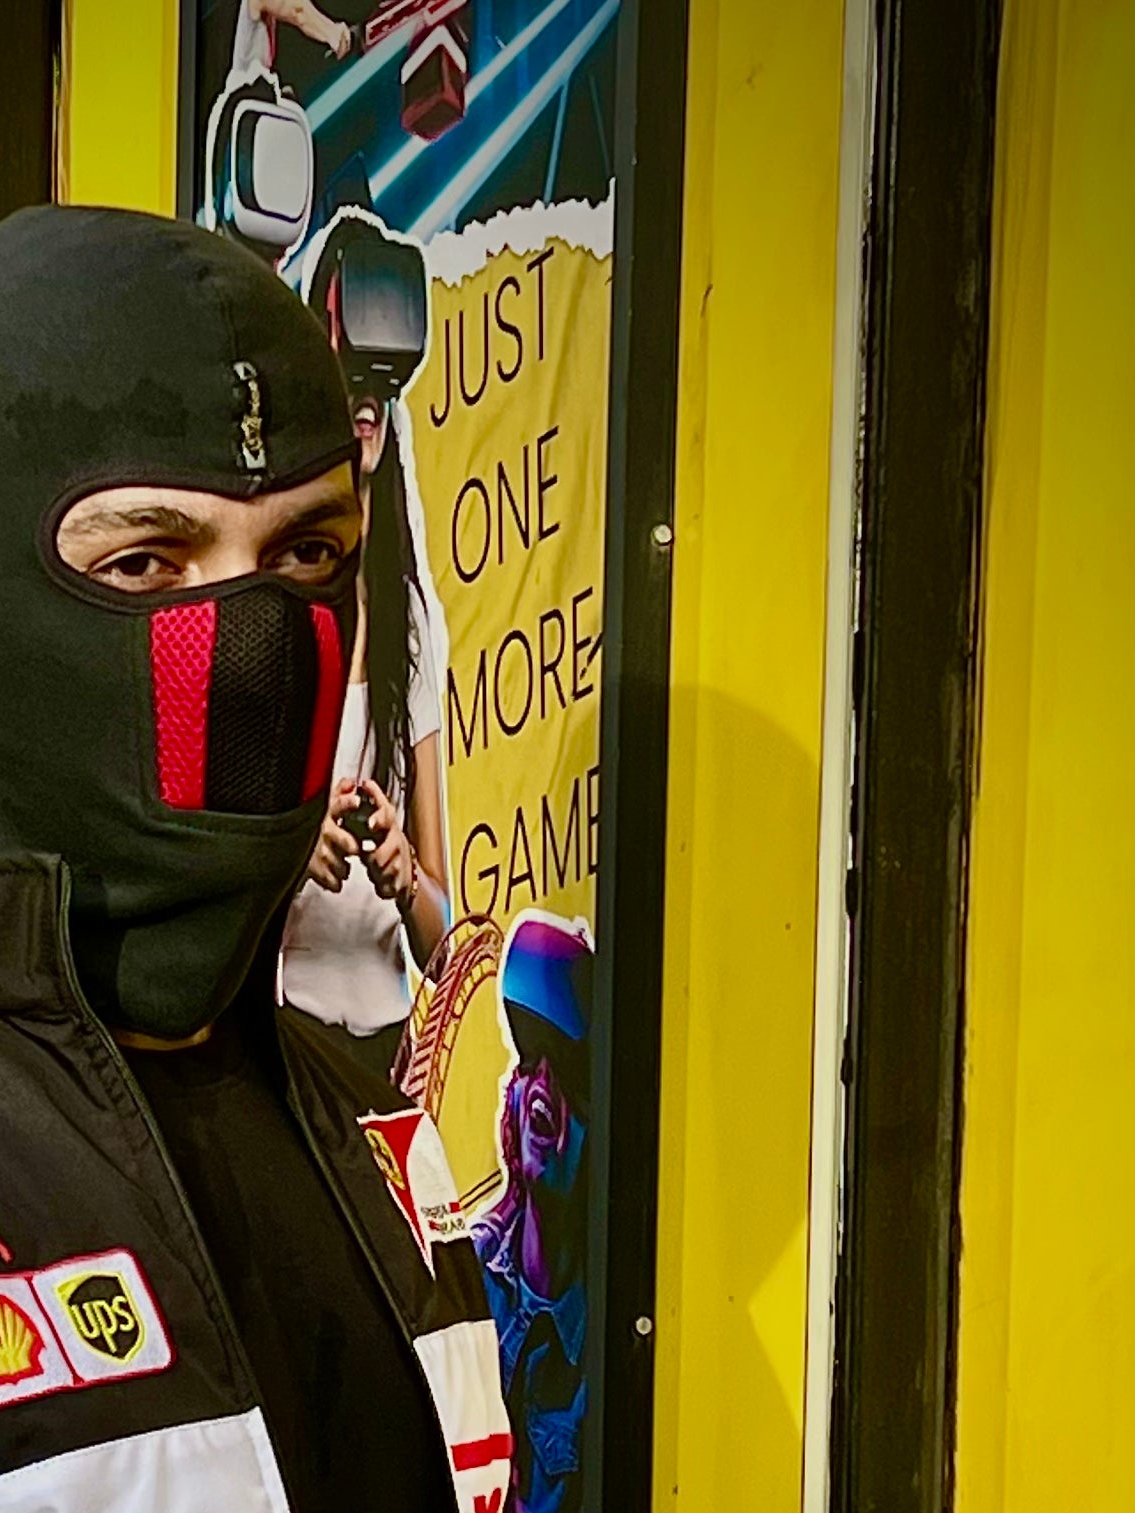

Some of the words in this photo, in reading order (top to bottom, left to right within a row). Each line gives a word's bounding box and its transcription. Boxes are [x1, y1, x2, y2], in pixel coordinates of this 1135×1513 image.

[430, 246, 554, 427] JUST
[452, 425, 560, 581] ONE
[447, 586, 593, 766] MORE
